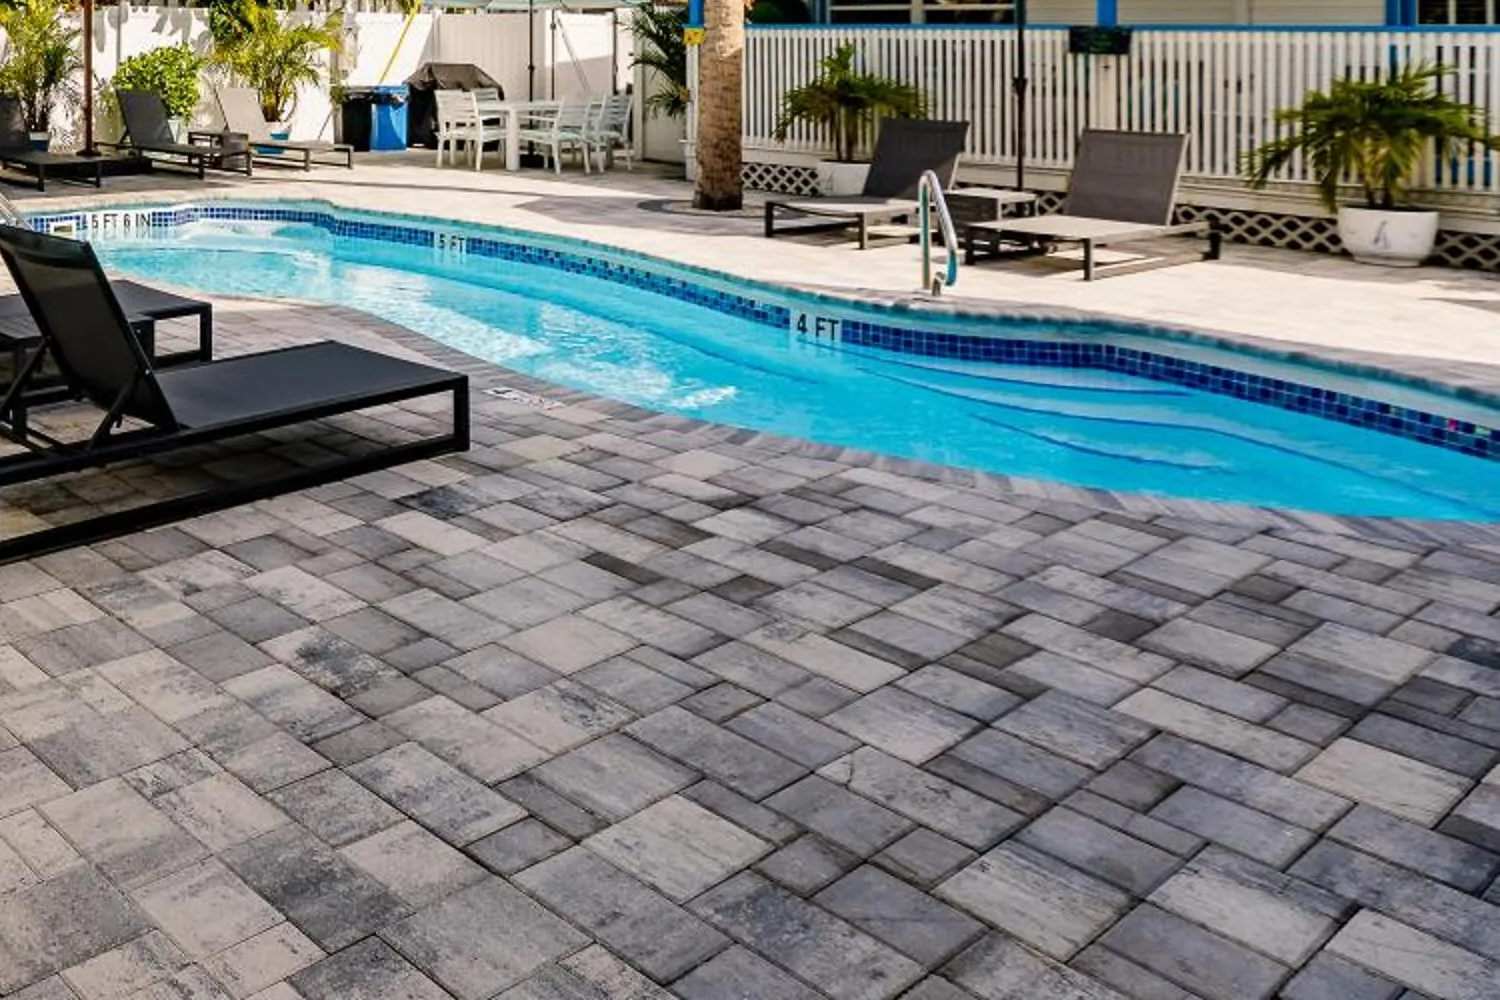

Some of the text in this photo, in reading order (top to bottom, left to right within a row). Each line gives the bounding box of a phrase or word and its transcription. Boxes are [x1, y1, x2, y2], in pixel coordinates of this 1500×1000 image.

[91, 213, 151, 229] 5 FT 6 IN
[450, 235, 465, 252] FT
[796, 313, 839, 341] 4 FT
